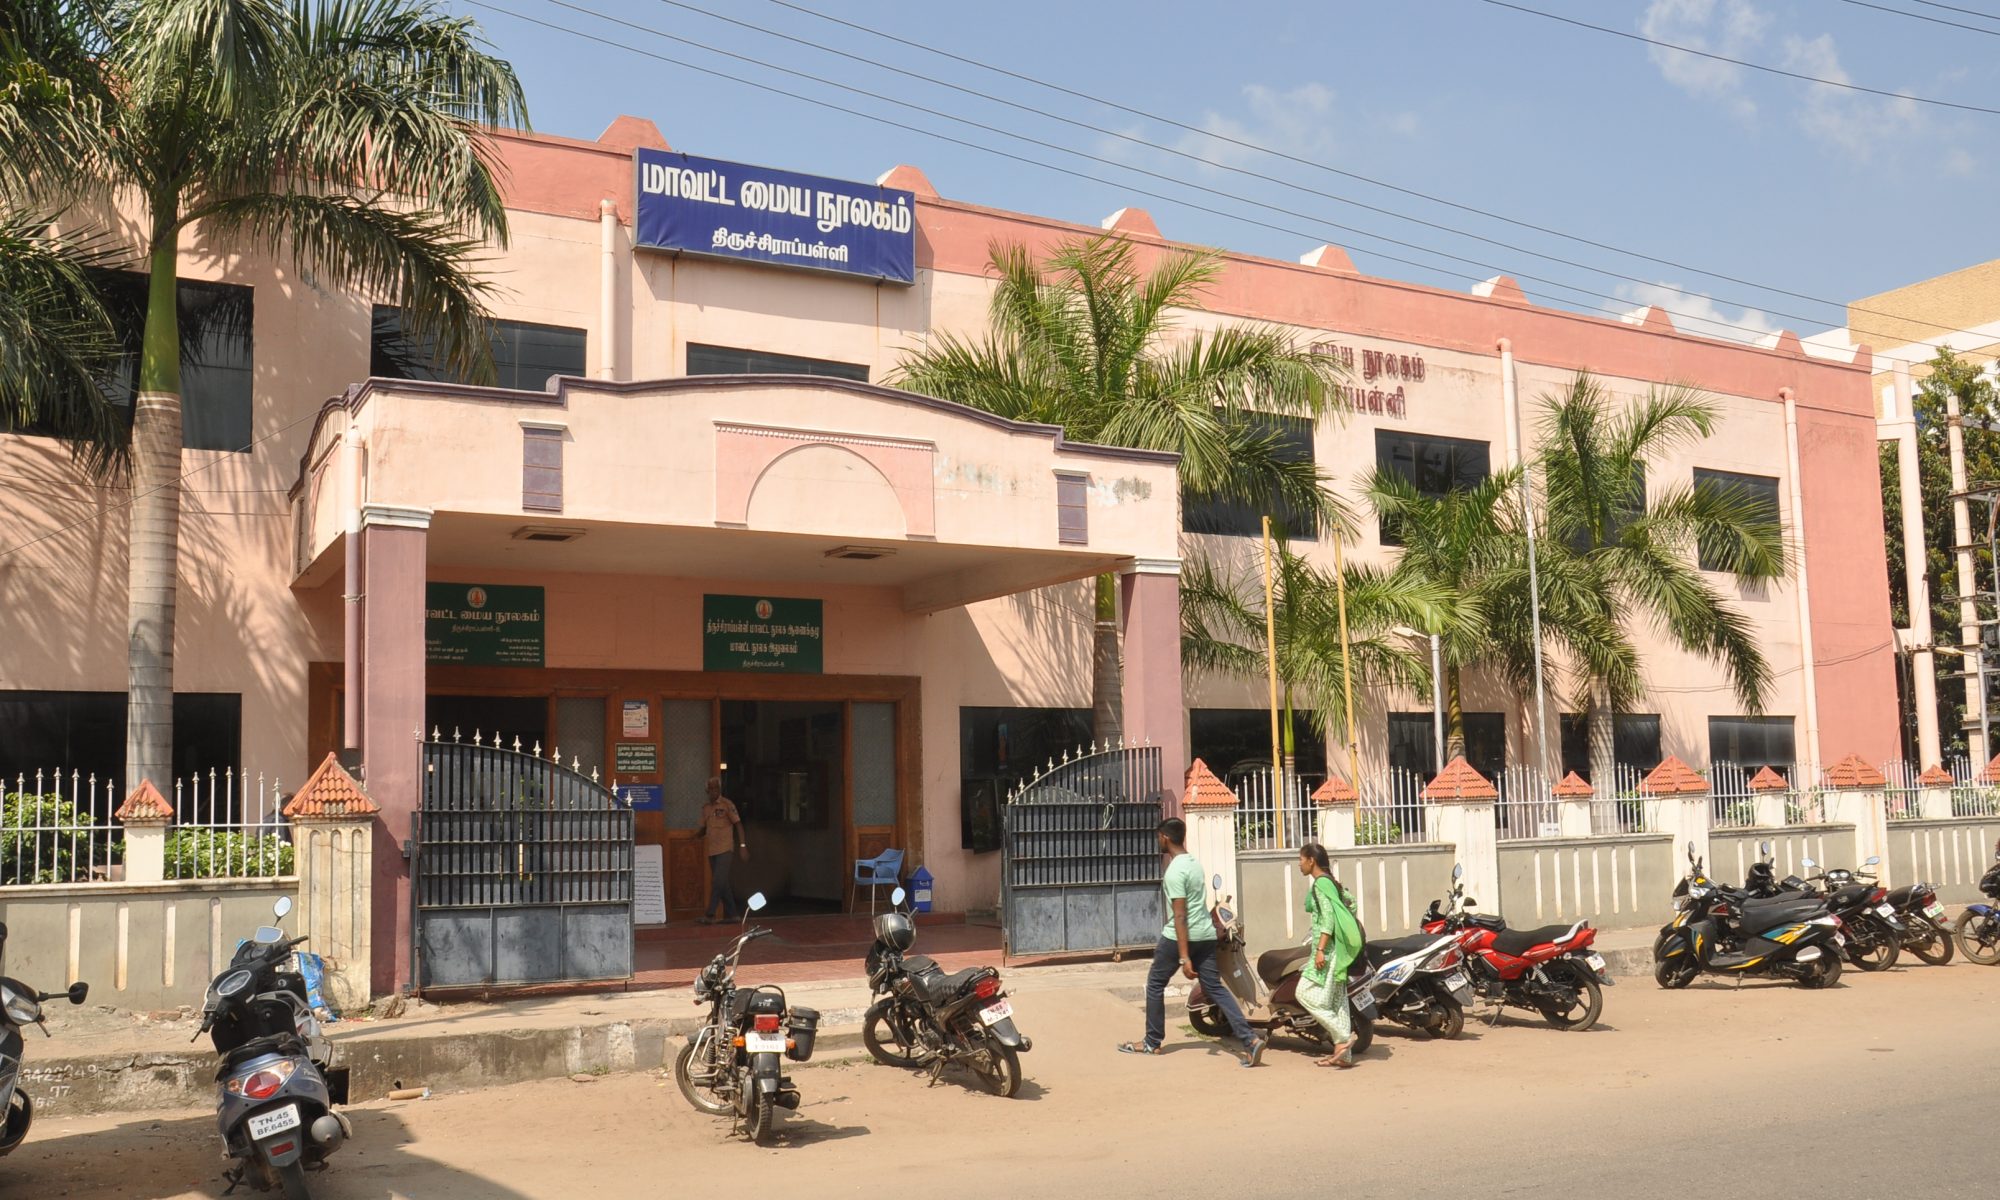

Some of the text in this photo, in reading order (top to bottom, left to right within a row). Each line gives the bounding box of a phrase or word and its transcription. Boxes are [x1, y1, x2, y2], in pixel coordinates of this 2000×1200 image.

[642, 162, 911, 234] மாவட்ட மைய நூலகம்
[711, 227, 848, 262] திருச்சிராப்பள்ளி
[1362, 349, 1425, 381] நூலகம்
[461, 610, 492, 621] மைய
[495, 609, 540, 625] நூலகம்
[257, 1118, 295, 1136] BF.6455
[258, 1111, 289, 1127] TN.45
